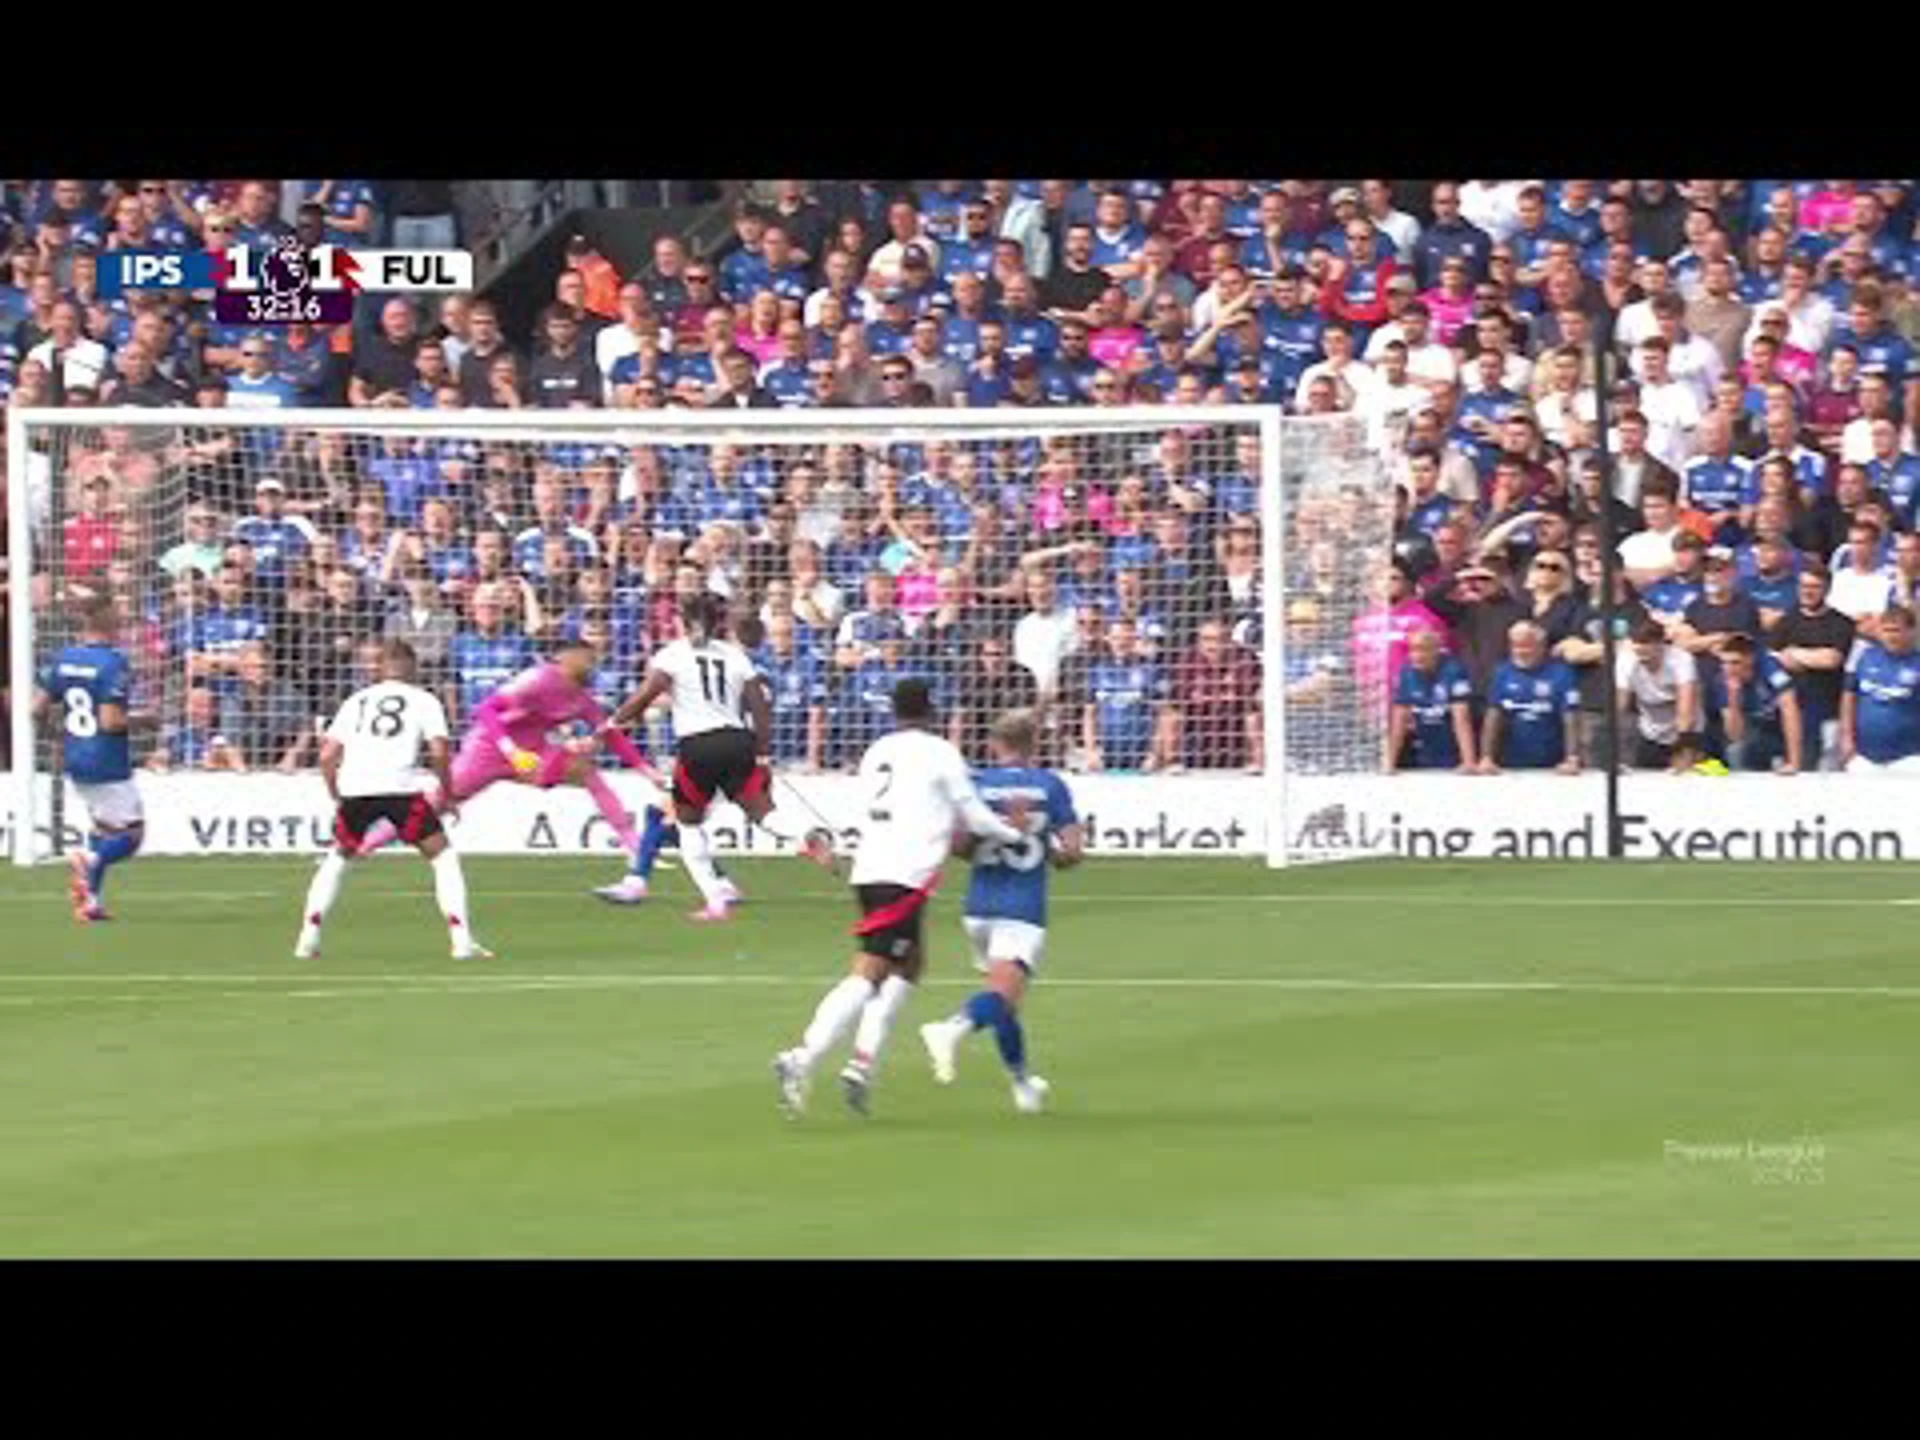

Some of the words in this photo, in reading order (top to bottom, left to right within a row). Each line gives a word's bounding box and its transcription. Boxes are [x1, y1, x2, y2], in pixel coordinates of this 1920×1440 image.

[695, 656, 726, 704] 11
[63, 688, 97, 737] 8
[355, 694, 407, 738] 18
[1492, 813, 1593, 860] and
[1610, 814, 1902, 861] Execution
